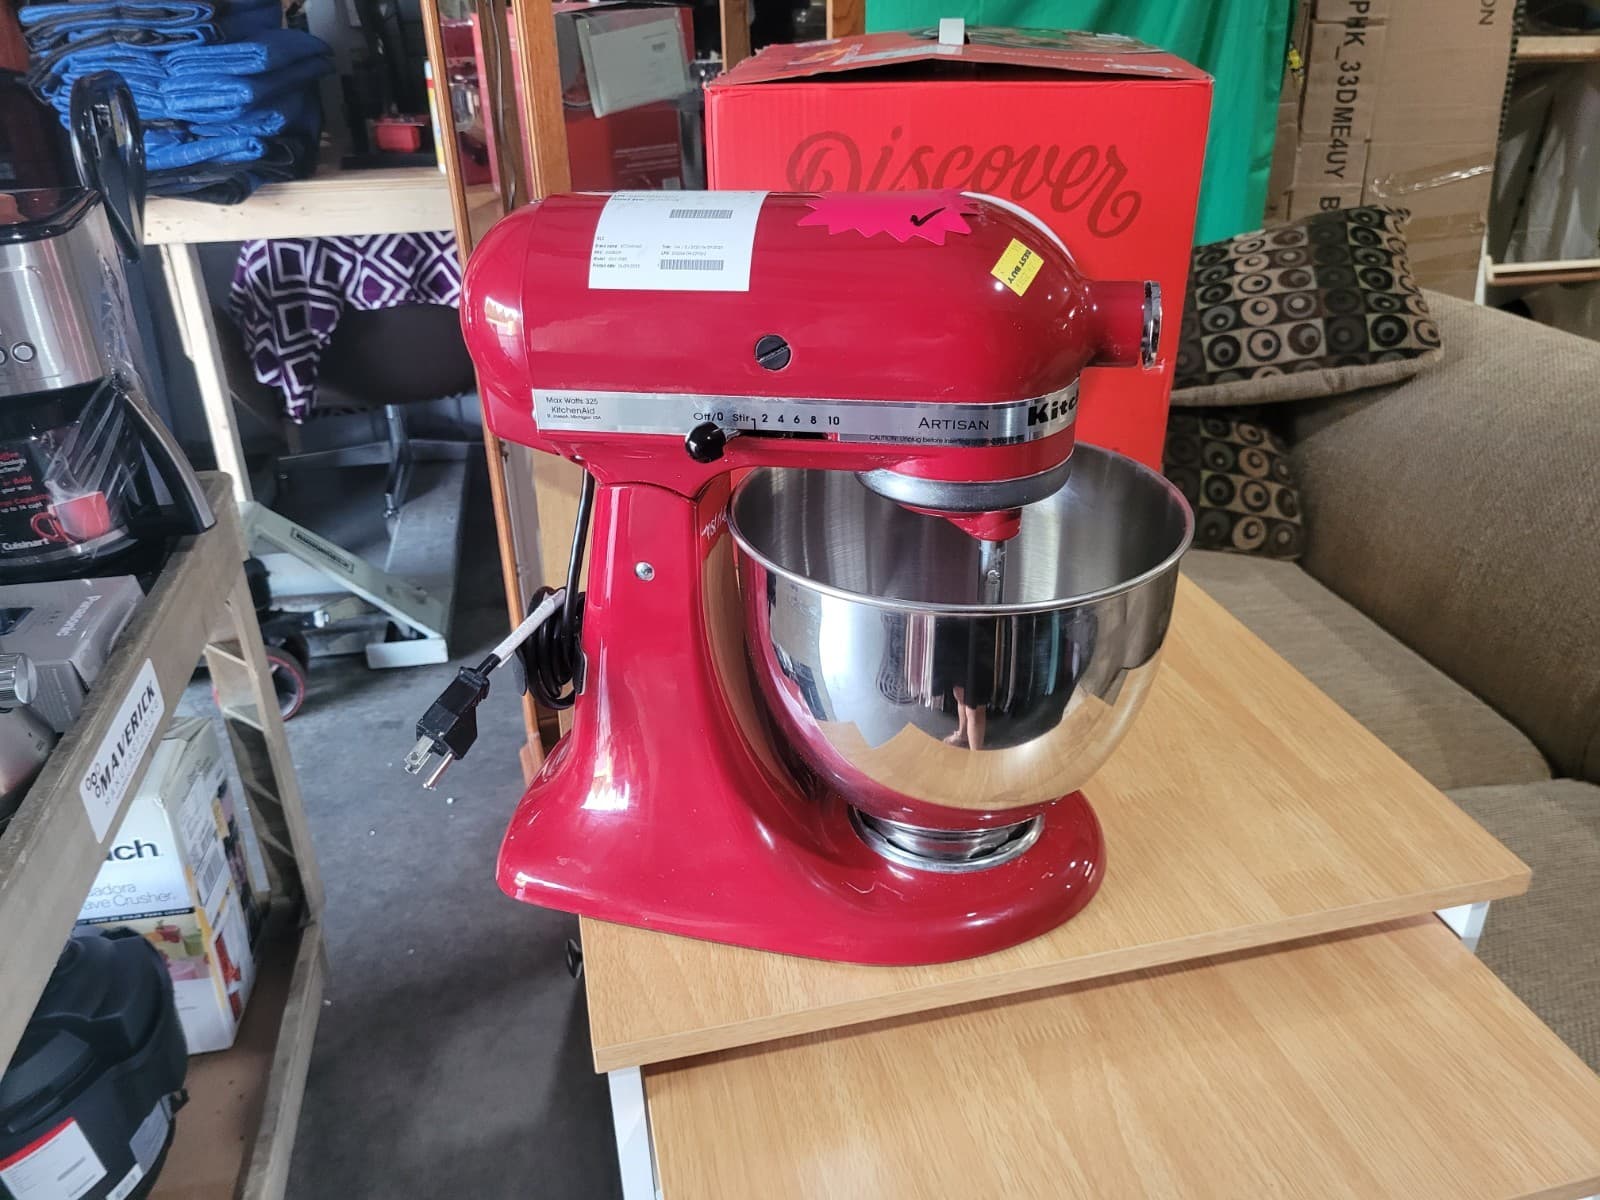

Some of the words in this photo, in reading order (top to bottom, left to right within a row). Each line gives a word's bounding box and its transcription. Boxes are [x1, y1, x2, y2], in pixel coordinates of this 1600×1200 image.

[786, 126, 1142, 239] Discover
[1018, 249, 1032, 267] BEST
[1007, 265, 1022, 284] BUY
[546, 396, 562, 404] Max
[563, 397, 584, 405] Watts
[1028, 388, 1079, 426] Kitc
[551, 406, 596, 415] KitchenAid
[732, 413, 750, 422] Stir
[761, 414, 769, 423] 2
[777, 414, 785, 424] 4
[793, 414, 801, 424] 6
[810, 415, 817, 425] 8
[828, 416, 840, 426] 10
[918, 416, 990, 431] ARTISAN
[2, 538, 49, 551] Cuisinart
[100, 680, 156, 797] MAVERICK
